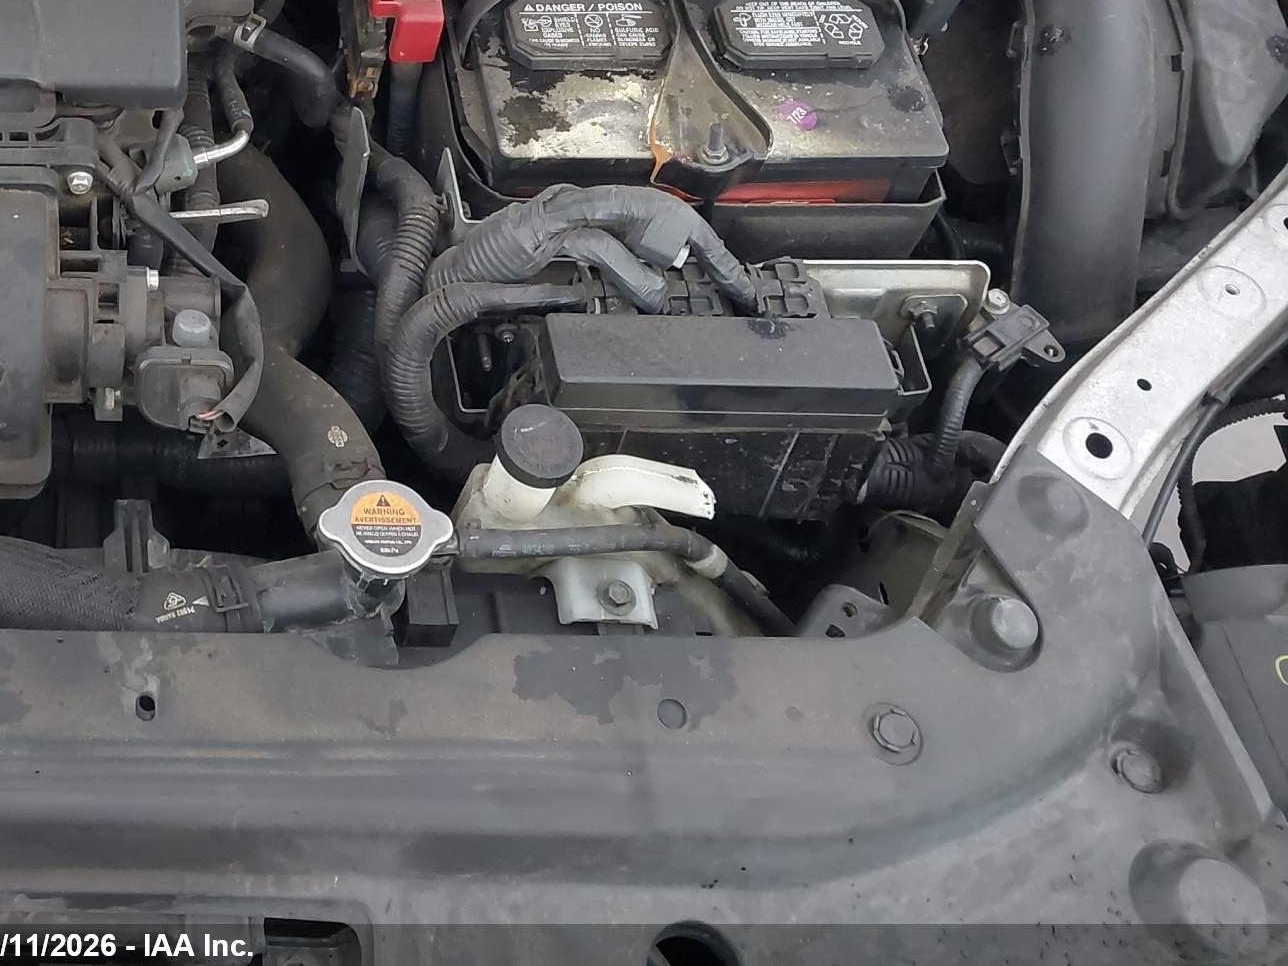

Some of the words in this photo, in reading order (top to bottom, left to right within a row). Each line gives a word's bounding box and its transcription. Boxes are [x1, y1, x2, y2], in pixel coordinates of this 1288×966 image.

[535, 3, 585, 12] DANGER
[588, 3, 594, 11] /
[598, 2, 643, 11] POISON
[363, 507, 405, 515] WARNING
